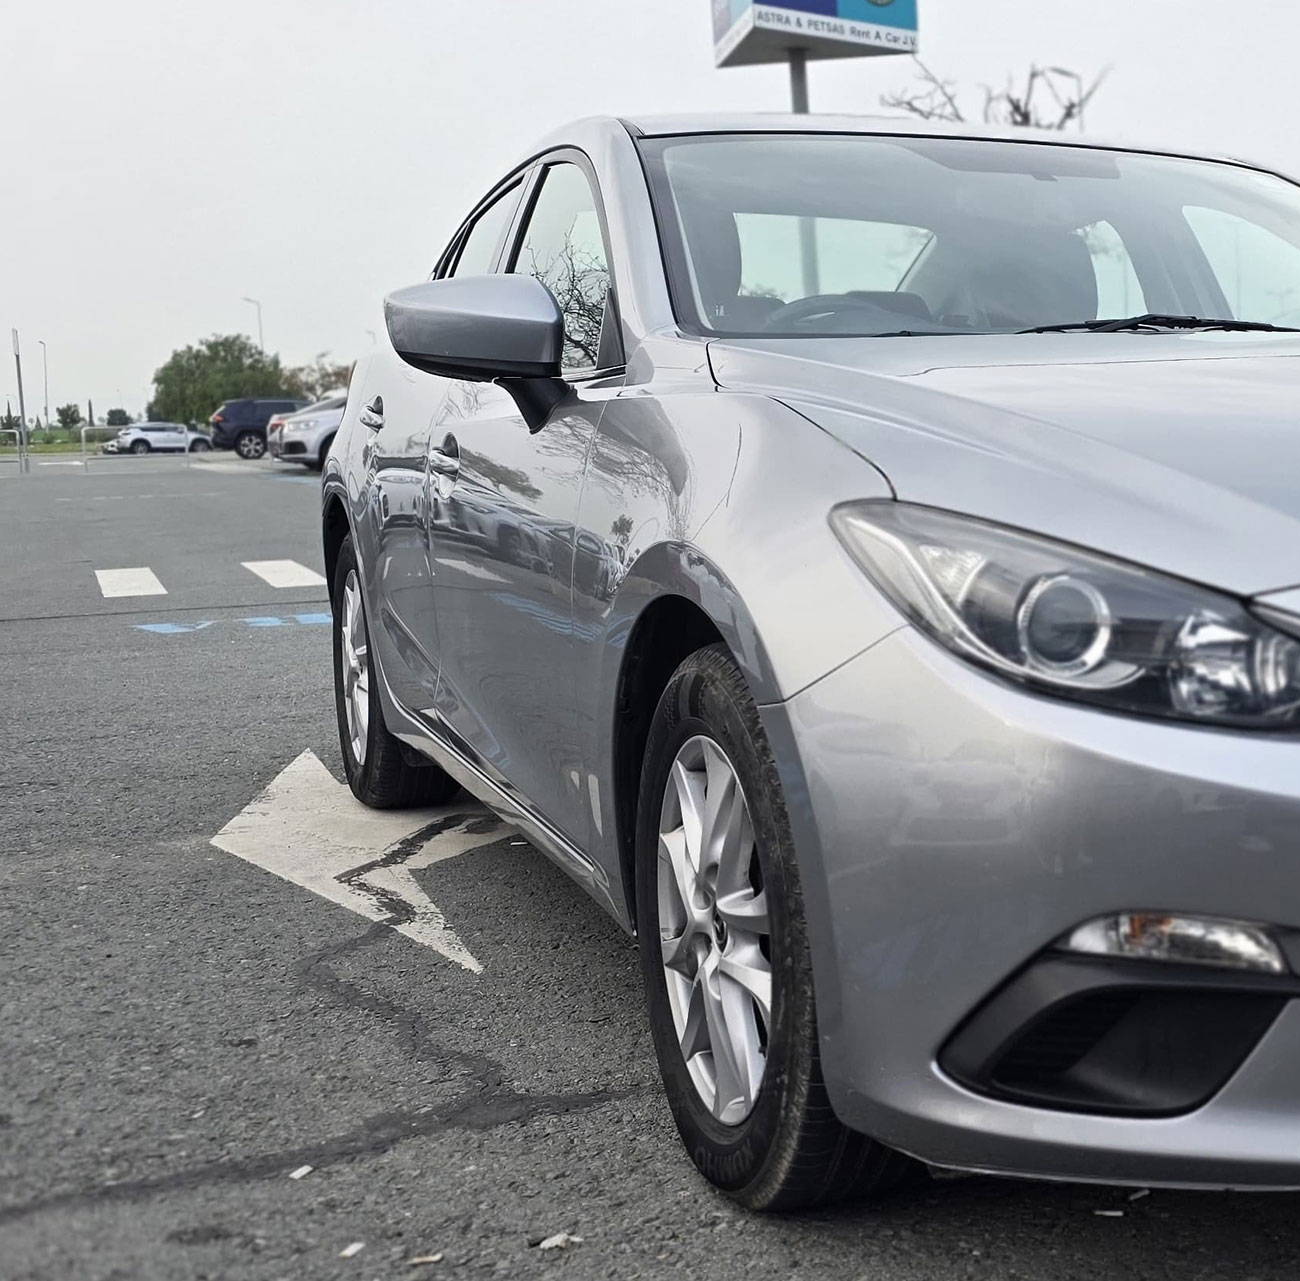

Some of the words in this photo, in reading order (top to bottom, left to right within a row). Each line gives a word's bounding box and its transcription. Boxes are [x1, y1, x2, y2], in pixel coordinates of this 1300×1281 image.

[757, 11, 791, 26] ASTRA
[796, 17, 803, 28] &
[807, 19, 844, 35] PETSAS
[849, 26, 871, 40] Rent
[874, 31, 882, 42] A
[885, 33, 901, 43] Car
[694, 1136, 755, 1184] KUMHO
